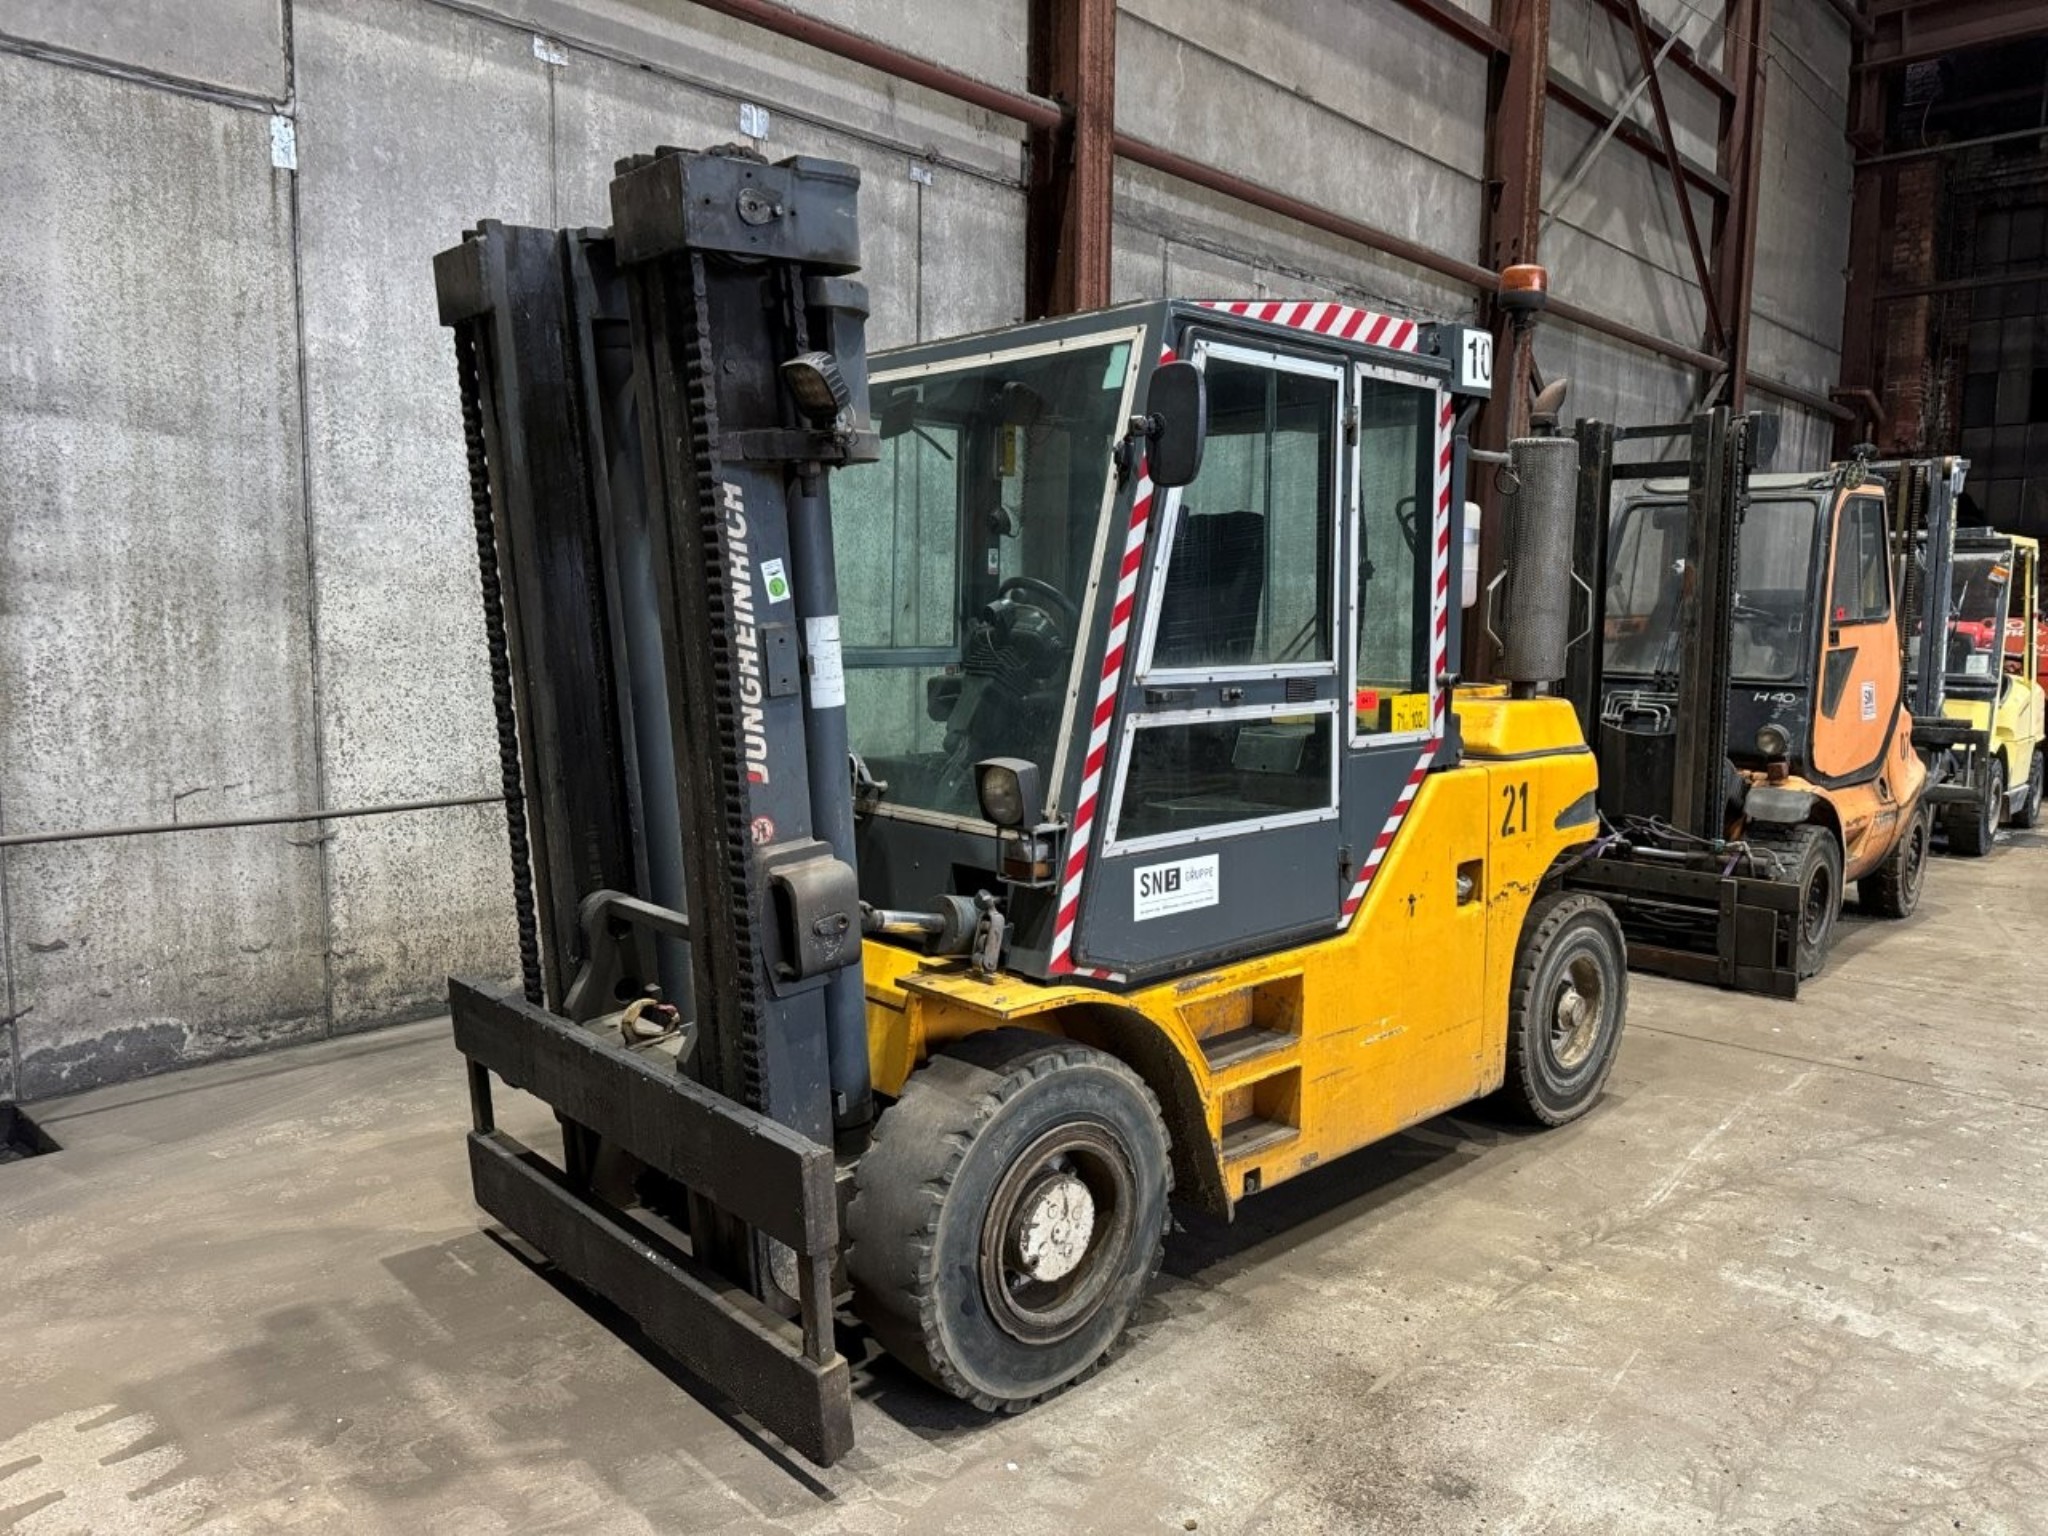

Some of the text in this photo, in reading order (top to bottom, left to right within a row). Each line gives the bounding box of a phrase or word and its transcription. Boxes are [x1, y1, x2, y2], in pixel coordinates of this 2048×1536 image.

[722, 481, 770, 785] JUNGHEINRICH
[1753, 691, 1796, 703] H 40
[1501, 781, 1529, 838] 21
